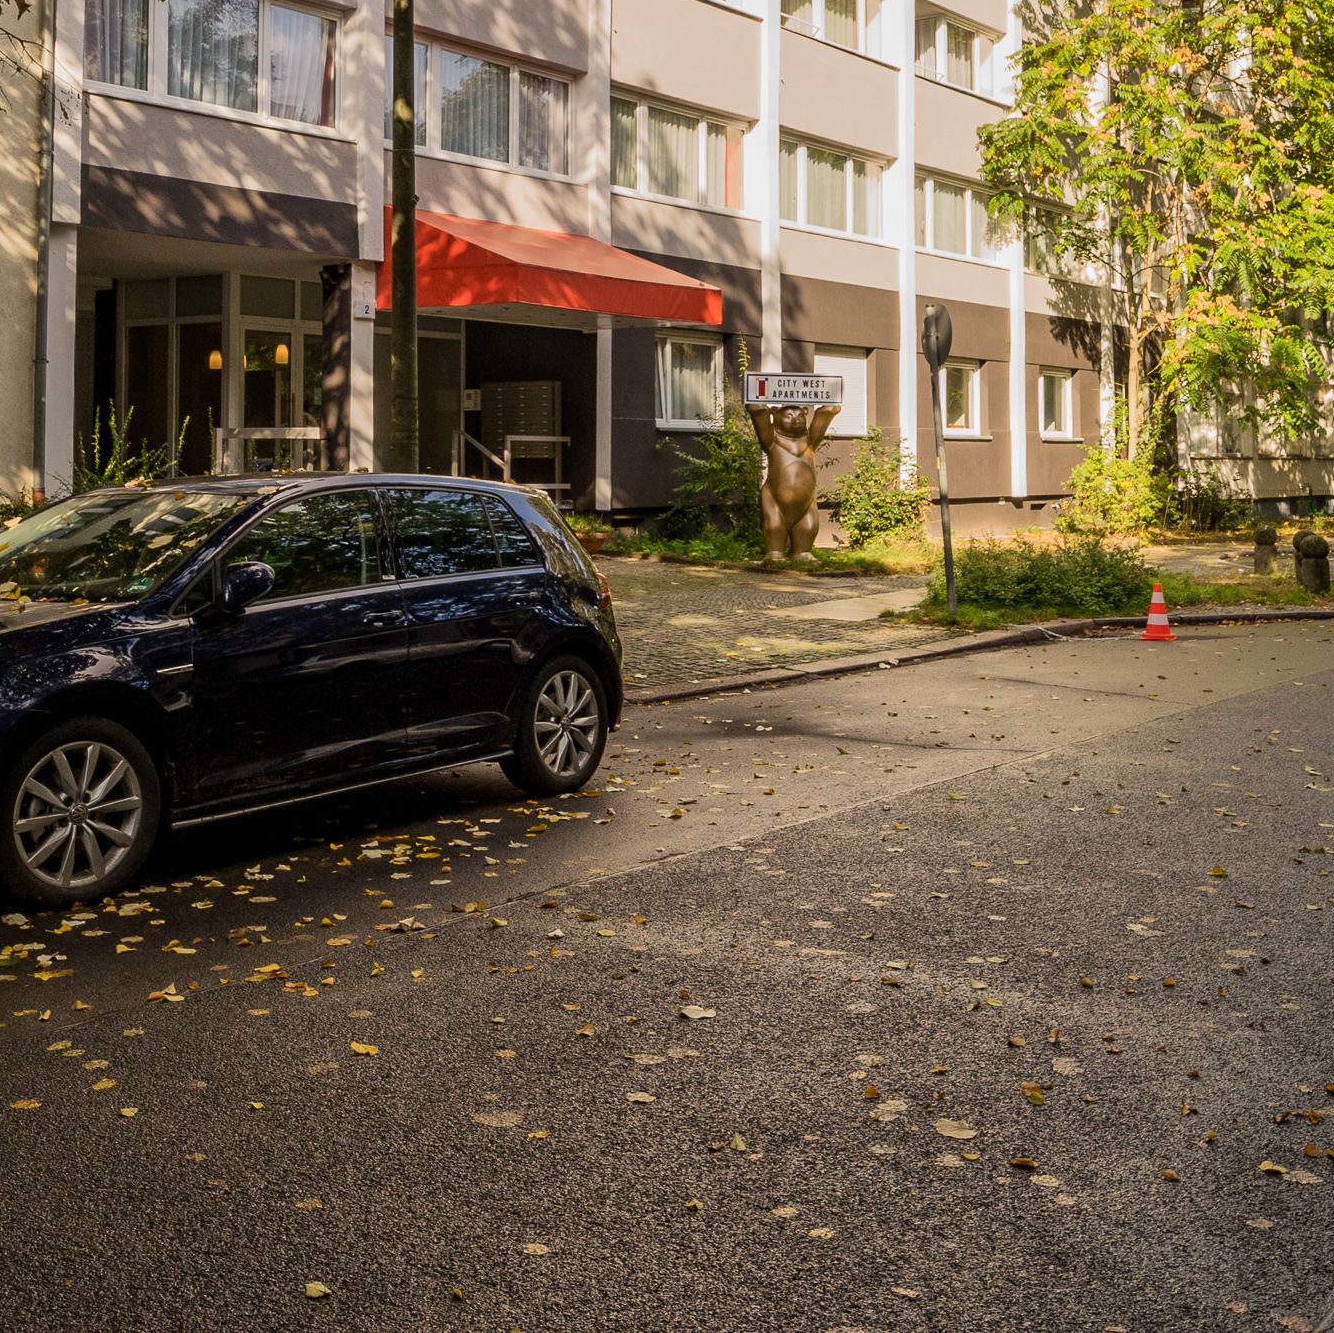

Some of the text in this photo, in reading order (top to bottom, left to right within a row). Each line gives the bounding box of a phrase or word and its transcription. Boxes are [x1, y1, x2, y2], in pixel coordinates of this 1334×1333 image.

[364, 304, 370, 315] 2
[777, 379, 826, 389] CITY WEST
[772, 390, 831, 400] APARTMENTS
